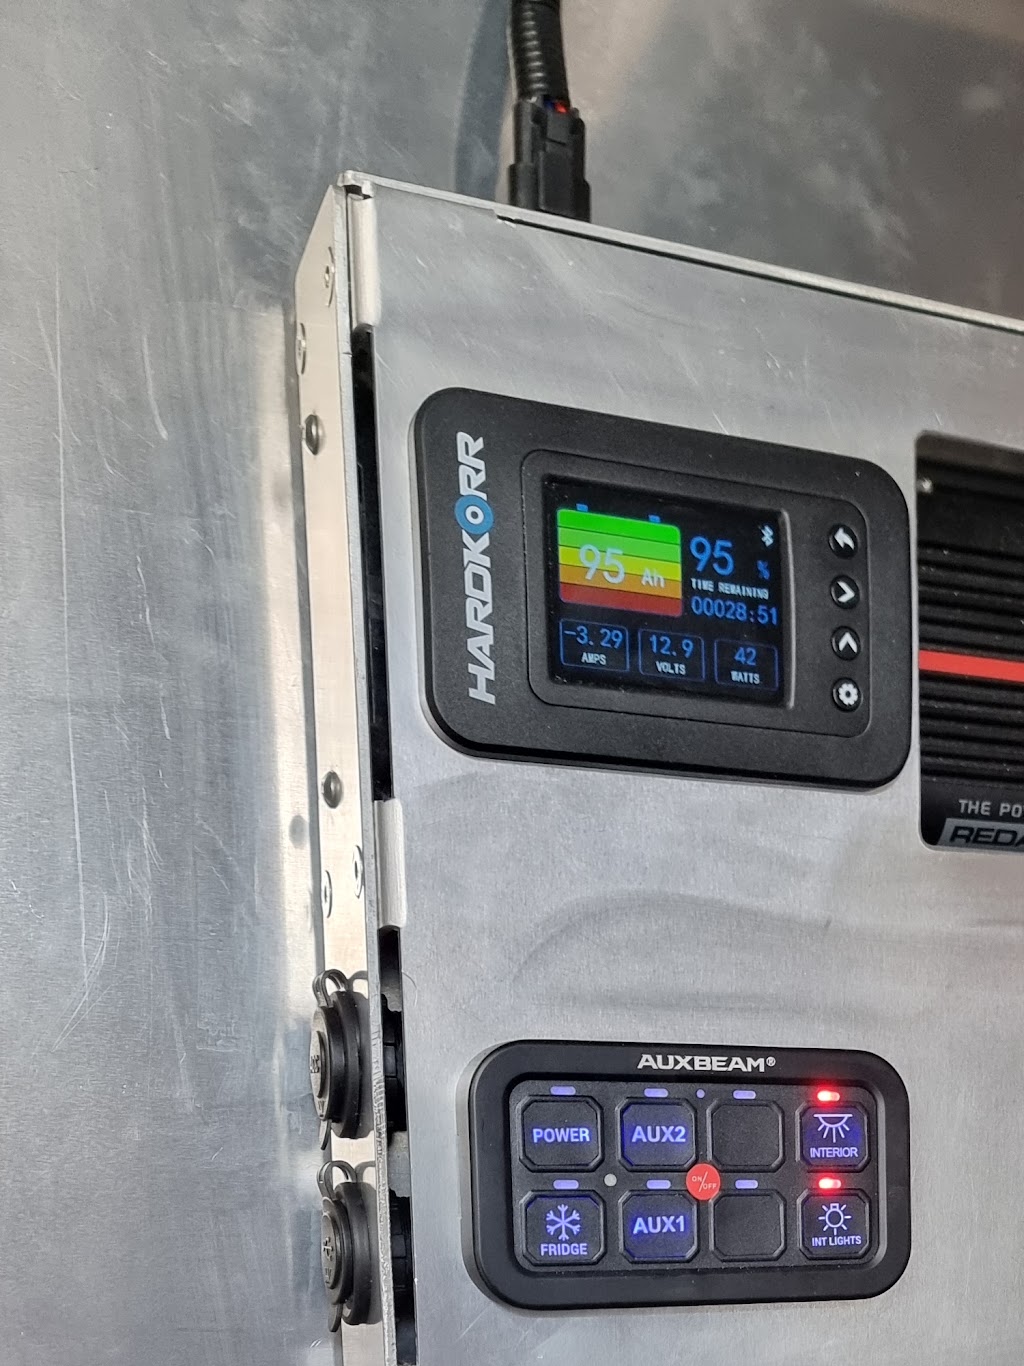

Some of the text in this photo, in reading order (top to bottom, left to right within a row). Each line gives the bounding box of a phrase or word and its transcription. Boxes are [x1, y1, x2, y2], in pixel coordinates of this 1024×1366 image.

[690, 535, 735, 576] 95
[455, 431, 496, 704] HARDKORR
[579, 544, 666, 588] 95 Ah
[691, 577, 769, 600] TIME REMAINING
[690, 596, 778, 626] 00028:51
[564, 625, 623, 649] -3.29
[650, 634, 694, 659] 12.9
[581, 652, 607, 666] AMPS
[734, 647, 757, 666] 42
[655, 661, 686, 676] VOLTS
[730, 671, 761, 685] WATTS
[958, 799, 992, 816] THE
[532, 1127, 590, 1143] POWER
[631, 1126, 686, 1143] AUX2
[810, 1147, 858, 1158] INTERIOR
[633, 1216, 685, 1234] AUX1
[540, 1243, 588, 1256] FRIDGE
[811, 1235, 862, 1247] INT LIGHTS
